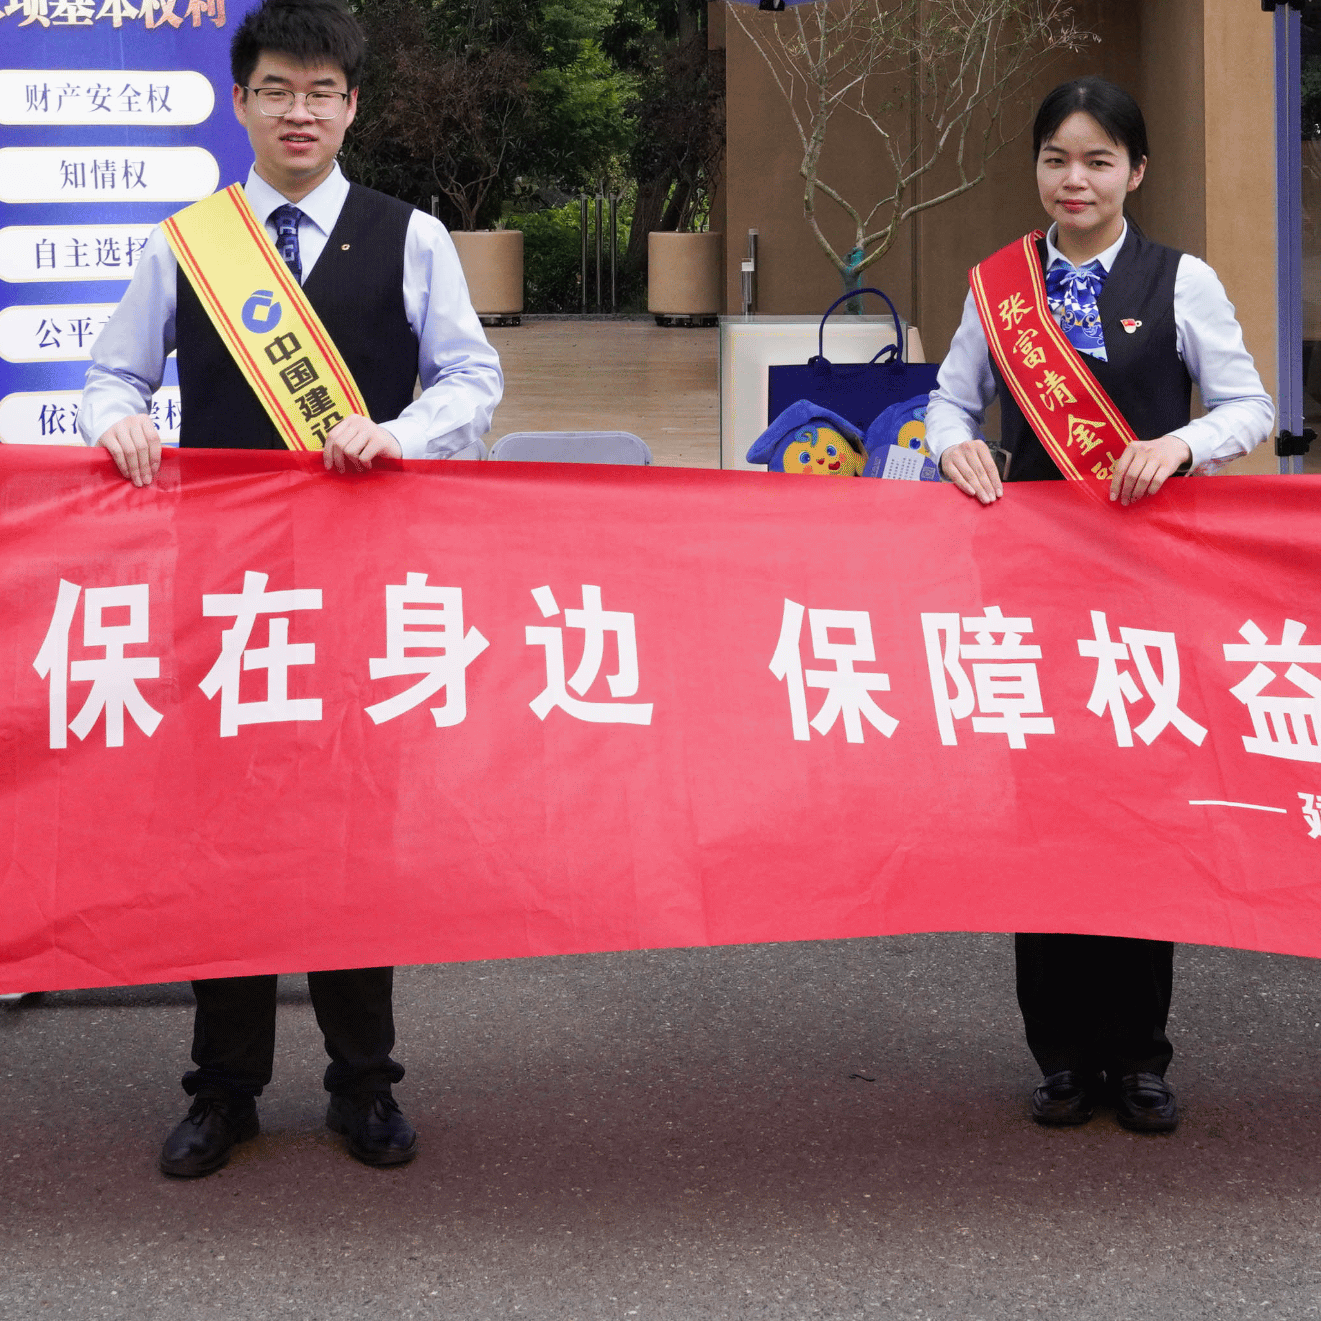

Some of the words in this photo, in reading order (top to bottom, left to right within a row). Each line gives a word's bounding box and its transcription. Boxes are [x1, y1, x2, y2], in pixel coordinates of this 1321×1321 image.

[25, 83, 172, 114] 财产安全权
[60, 159, 148, 190] 知情权
